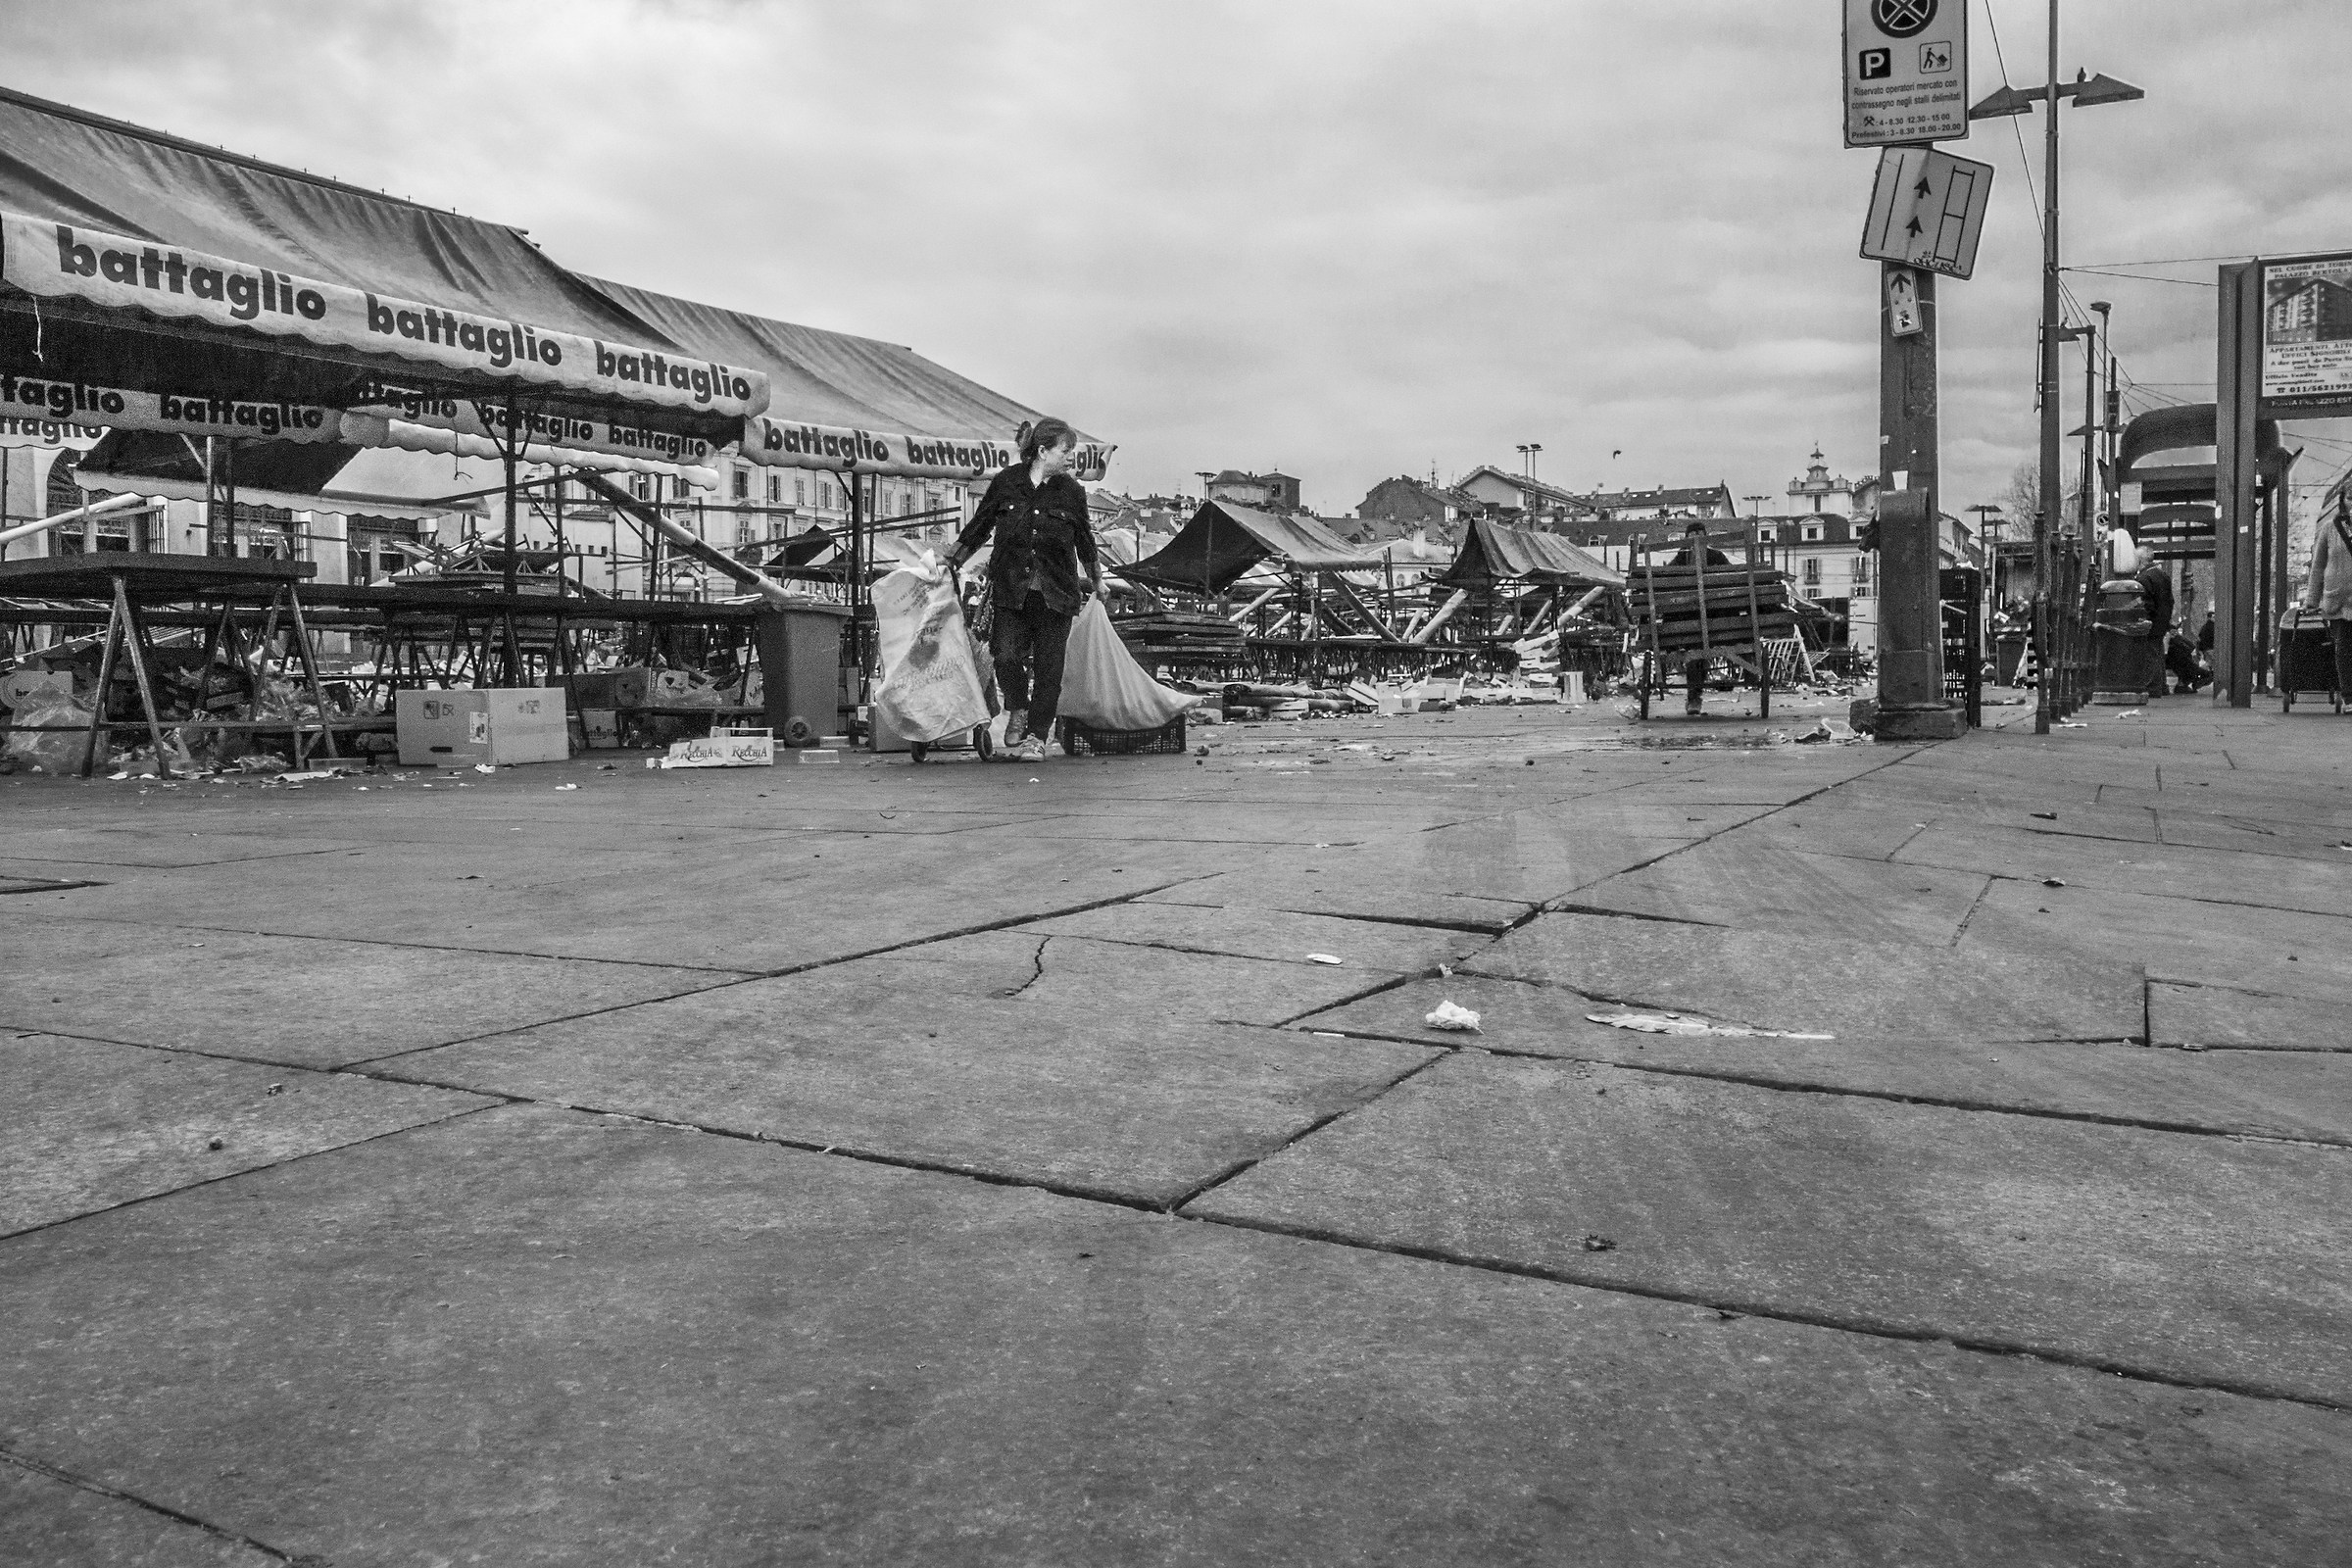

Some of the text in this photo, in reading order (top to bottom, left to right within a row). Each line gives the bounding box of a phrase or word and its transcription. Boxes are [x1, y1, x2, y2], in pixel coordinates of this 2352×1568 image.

[1851, 93, 1961, 110] contrassegno negli stalli delimitati
[1853, 79, 1958, 96] Riservato operatori mercato con
[1941, 122, 1961, 131] 20.00
[56, 224, 752, 404] battaglio battaglio battaglio
[161, 390, 323, 435] battaglio
[610, 419, 707, 460] battaglio
[762, 417, 890, 467] battaglio
[905, 435, 1010, 476] battaglio
